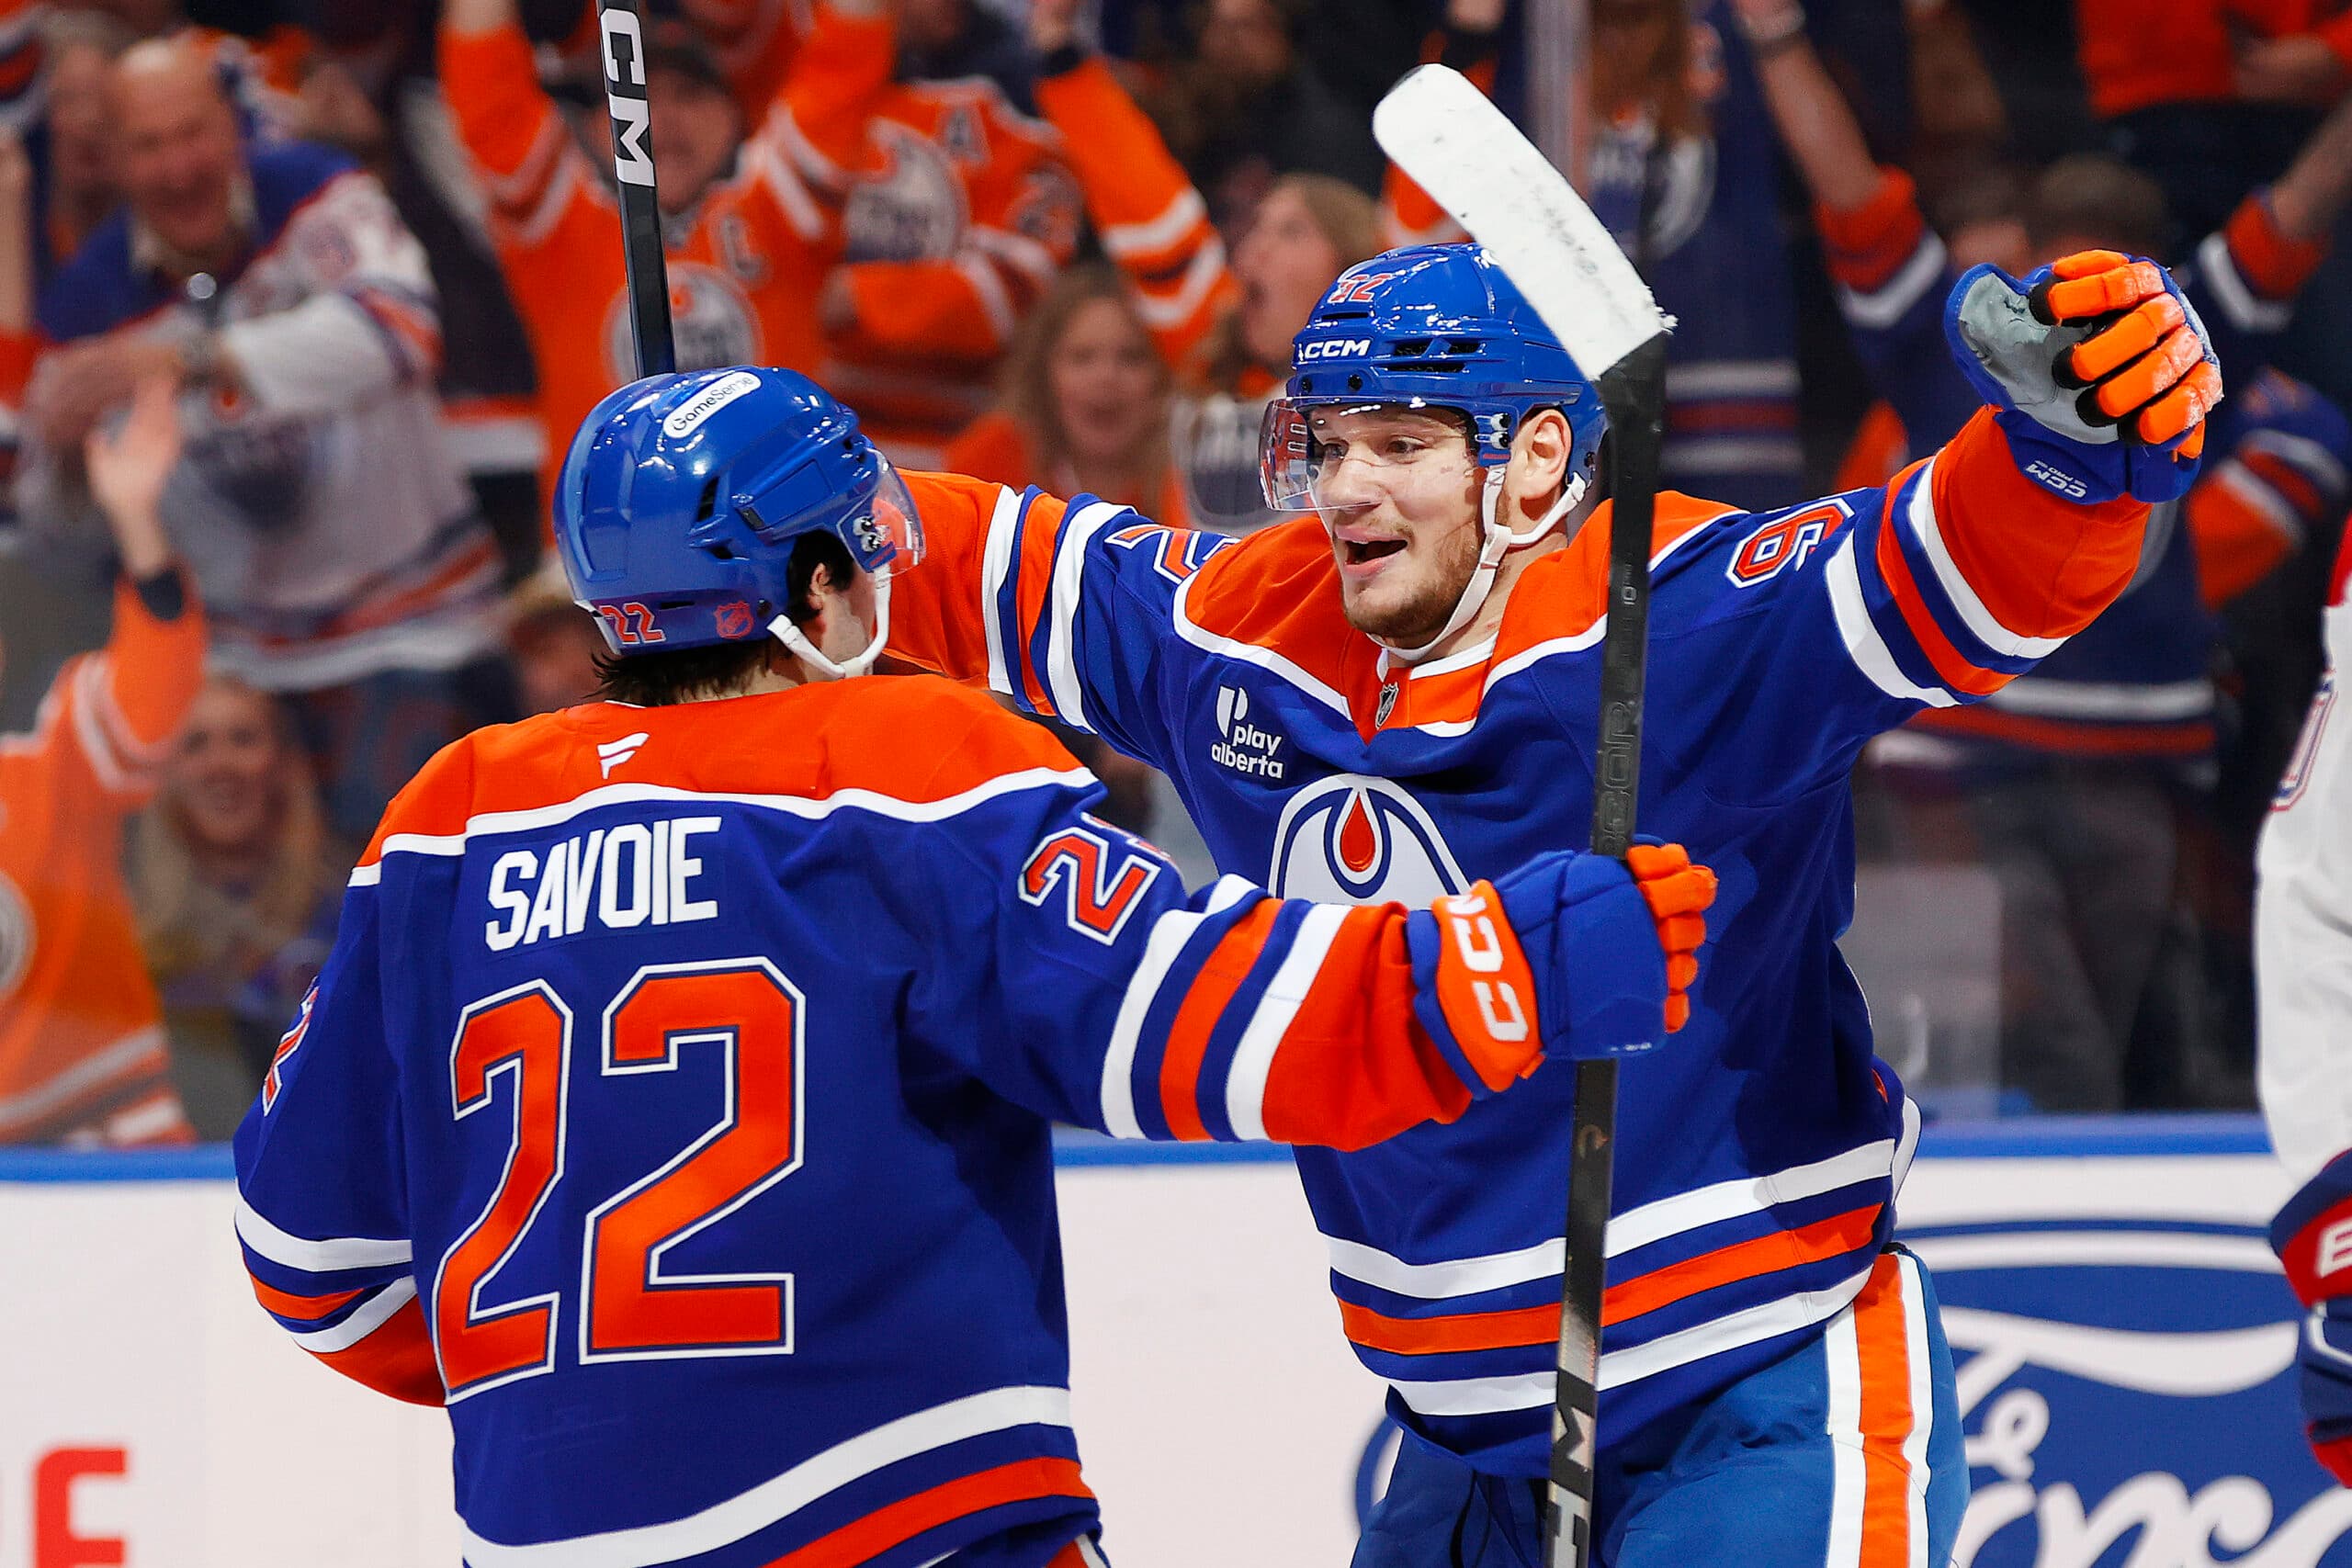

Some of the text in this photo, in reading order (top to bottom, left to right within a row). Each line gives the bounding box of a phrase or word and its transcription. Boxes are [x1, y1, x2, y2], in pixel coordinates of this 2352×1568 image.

[1305, 340, 1372, 359] CCM
[673, 376, 753, 431] GameSene
[2025, 463, 2086, 498] CCM
[598, 602, 666, 645] 22
[1232, 724, 1282, 756] play
[1211, 742, 1283, 778] alberta
[485, 817, 722, 952] SAVOIE
[431, 956, 807, 1404] 22
